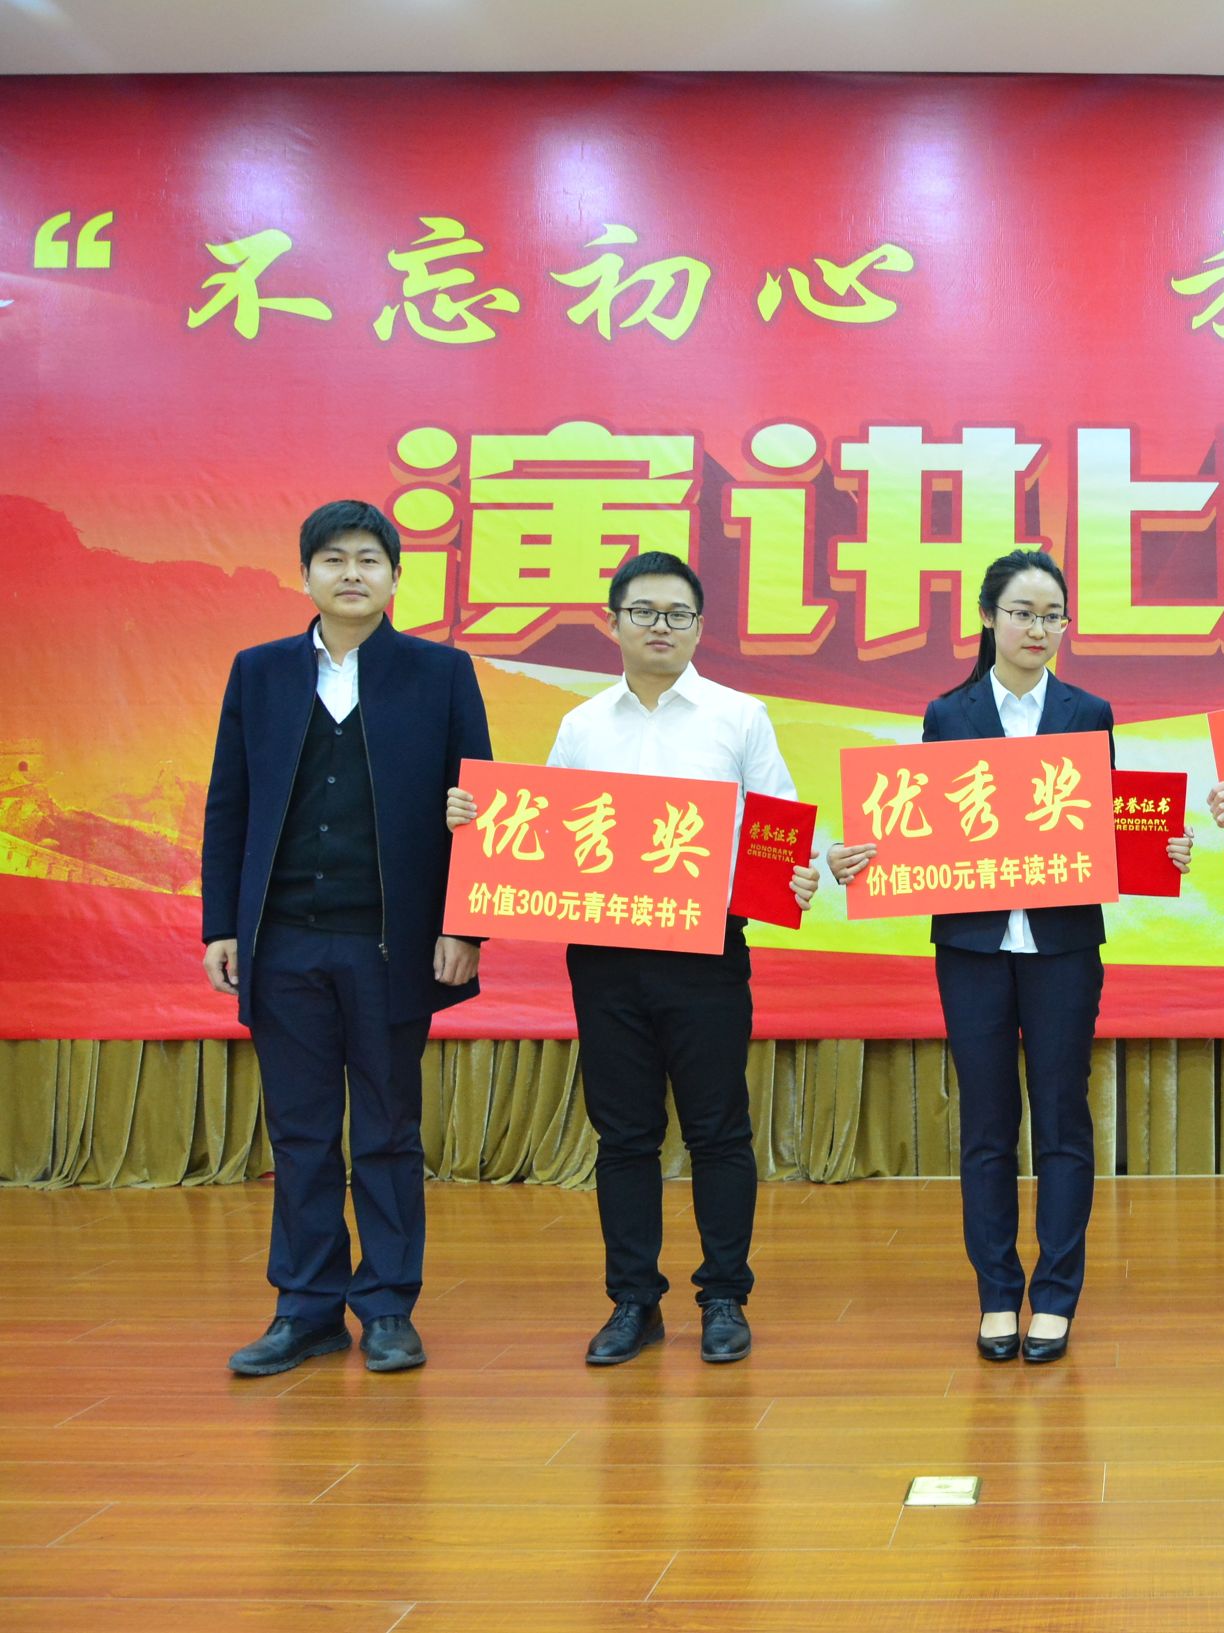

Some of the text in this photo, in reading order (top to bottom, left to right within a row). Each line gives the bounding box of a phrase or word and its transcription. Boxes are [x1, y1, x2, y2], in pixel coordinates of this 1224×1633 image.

[862, 756, 1092, 842] 优秀奖
[1113, 796, 1171, 815] 荣誉证书
[1114, 817, 1167, 825] HONORARY
[1116, 824, 1169, 832] REDENTIAL
[476, 788, 711, 878] 优秀奖
[749, 821, 799, 846] 荣誉证书
[747, 848, 795, 864] CREDENTIAL
[750, 843, 793, 857] HONORARY
[866, 852, 1093, 897] 价值300元青年读书卡
[468, 882, 702, 931] 价值300元青年读书卡
